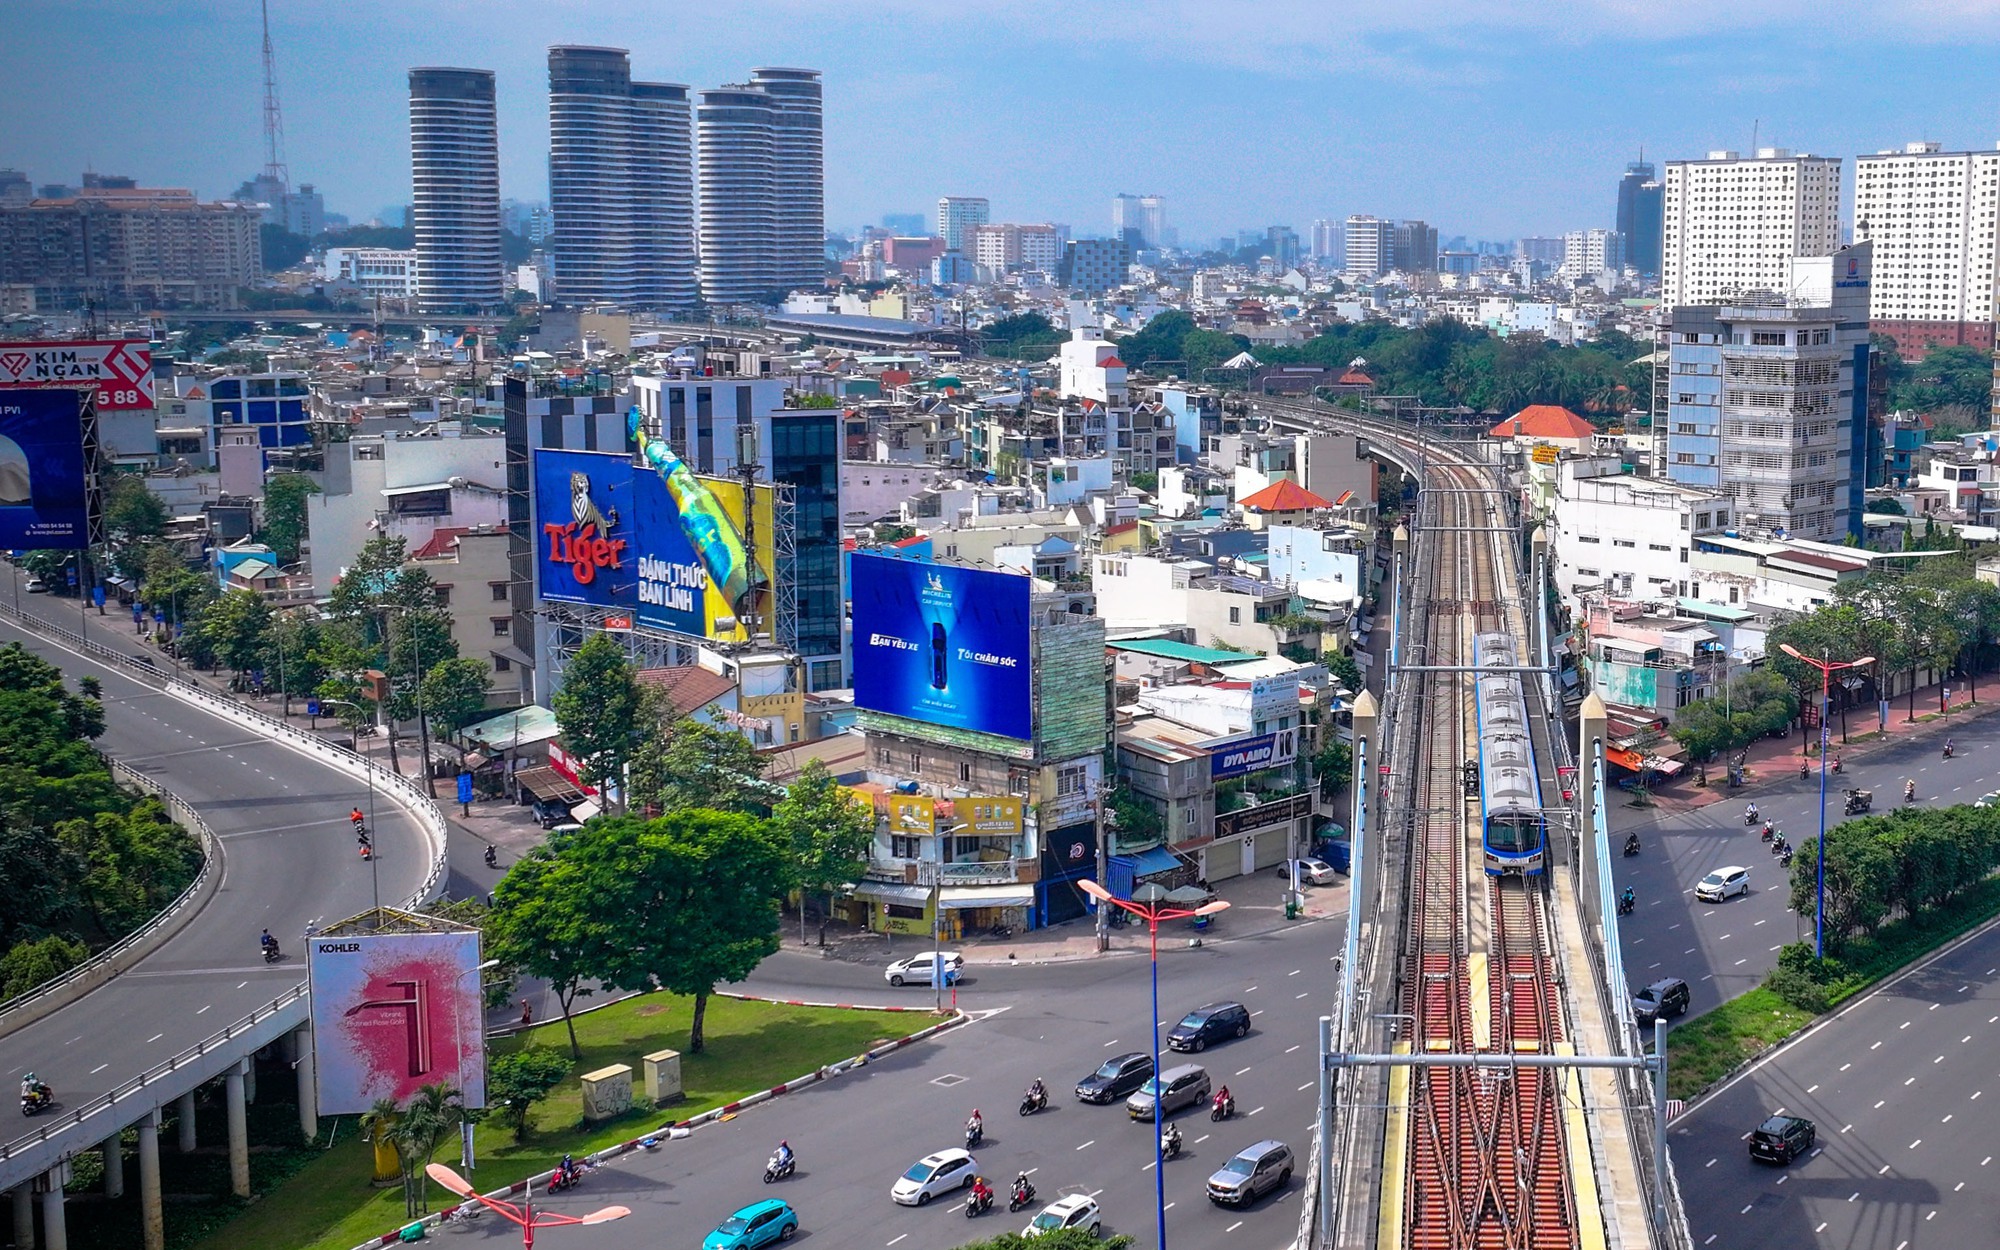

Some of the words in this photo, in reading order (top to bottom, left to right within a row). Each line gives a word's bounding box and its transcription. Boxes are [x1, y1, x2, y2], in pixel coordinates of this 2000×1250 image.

[35, 352, 77, 364] KIM
[36, 364, 100, 377] NGAN
[114, 390, 138, 404] 88
[4, 406, 20, 414] PVI
[544, 522, 626, 584] Tiger
[638, 554, 672, 583] ĐÁNH
[672, 562, 706, 590] THỨC
[664, 582, 693, 612] LĨNH
[922, 589, 952, 598] MICHELIN
[892, 639, 908, 650] YÊU
[908, 642, 919, 651] XE
[1000, 656, 1018, 668] SÓC
[1222, 746, 1271, 768] DYNAMO
[1246, 760, 1270, 772] TIRES
[1264, 808, 1280, 820] NAM
[319, 944, 360, 954] KOHLER
